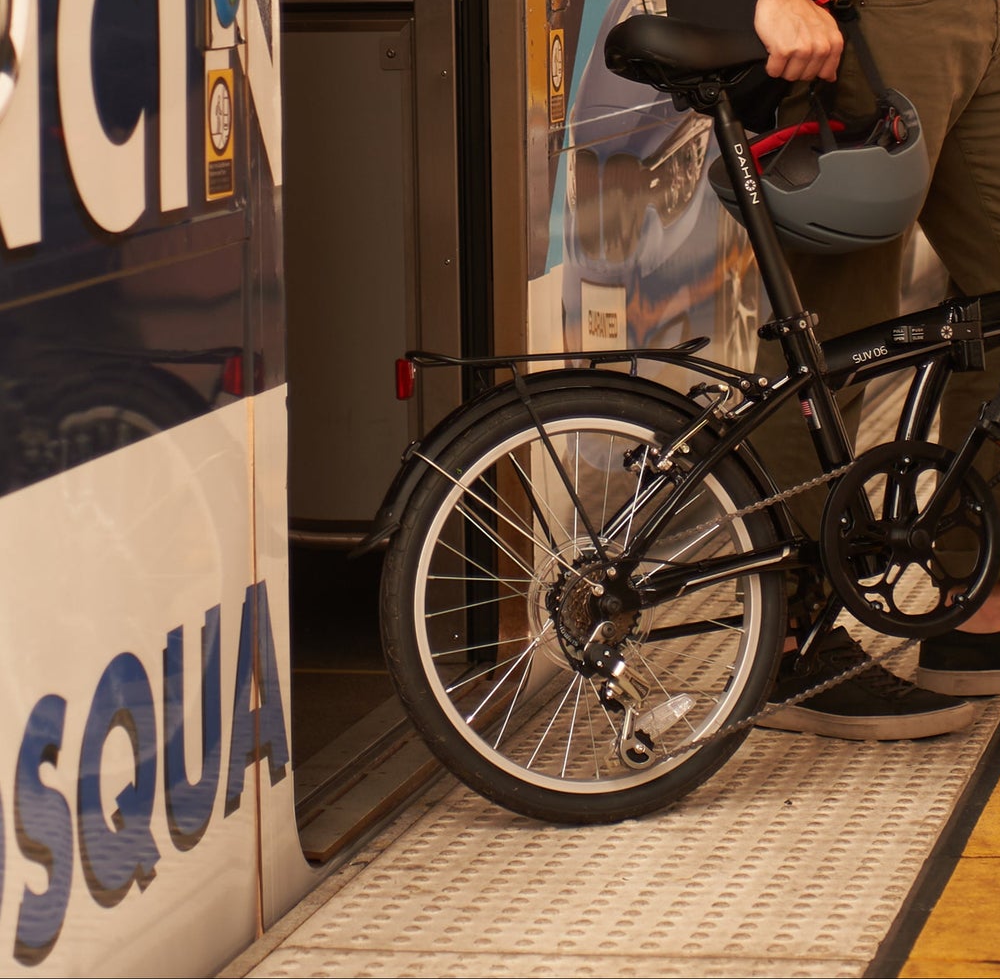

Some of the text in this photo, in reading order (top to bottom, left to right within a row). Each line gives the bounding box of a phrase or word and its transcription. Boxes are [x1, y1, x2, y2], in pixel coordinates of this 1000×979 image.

[734, 143, 760, 205] DAHON
[852, 345, 888, 364] SUV 06
